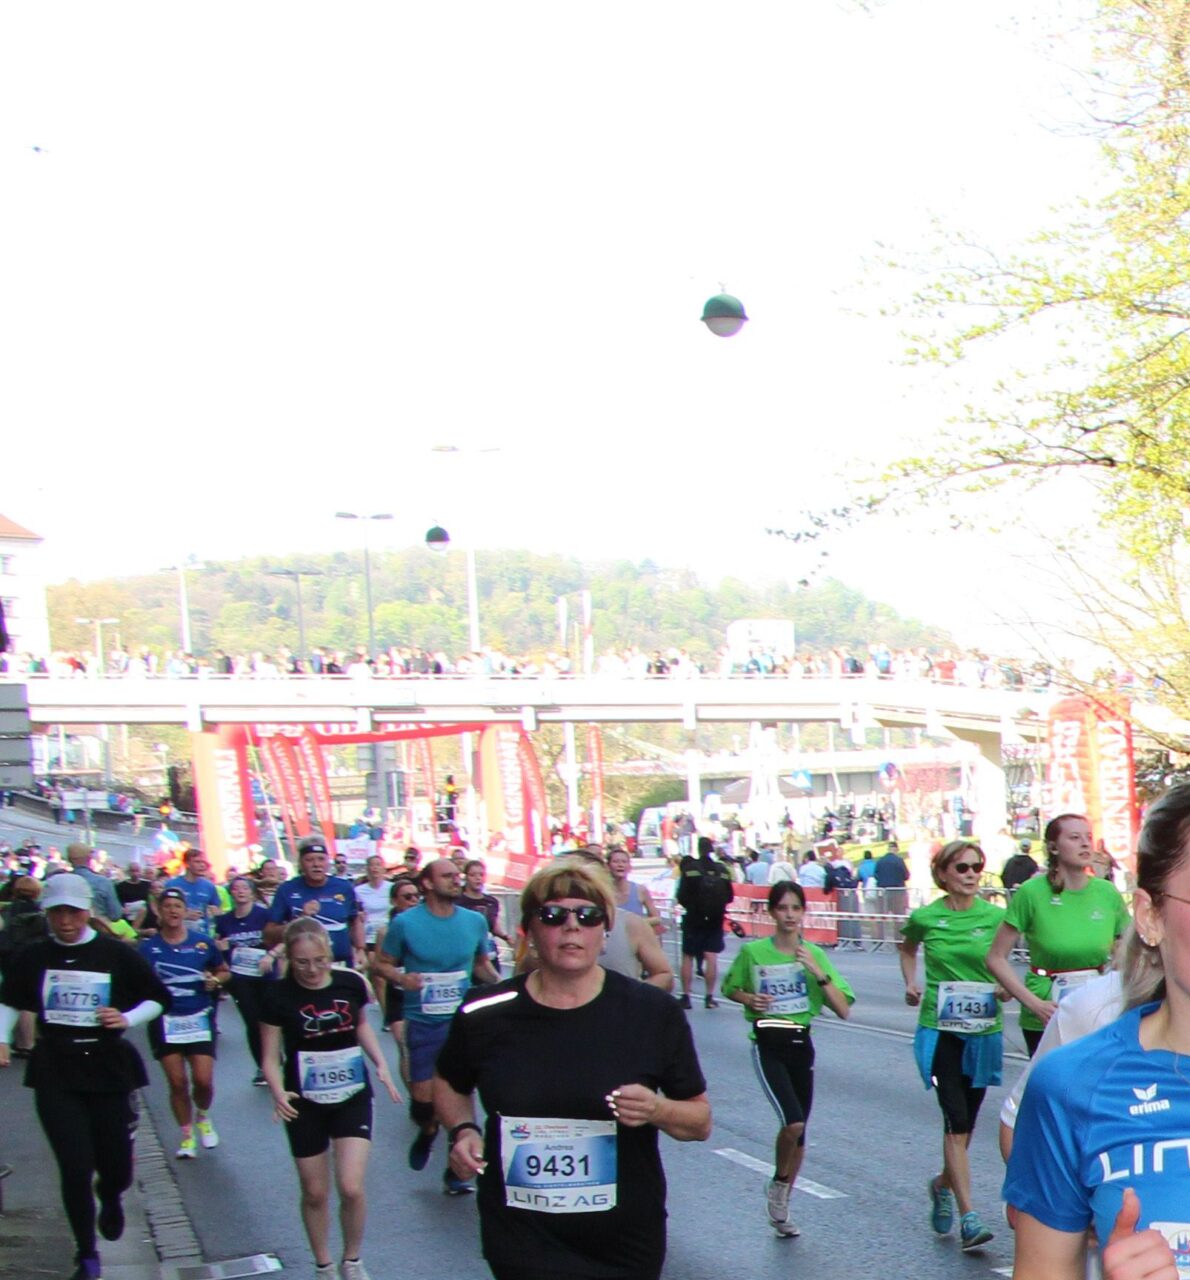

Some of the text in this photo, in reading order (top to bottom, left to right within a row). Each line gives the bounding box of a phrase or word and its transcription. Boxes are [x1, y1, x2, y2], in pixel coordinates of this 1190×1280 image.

[947, 1002, 990, 1015] 11431
[309, 1068, 355, 1084] 11963
[1129, 1099, 1170, 1116] erima
[526, 1154, 589, 1176] 9431
[513, 1191, 608, 1207] LINZ AG
